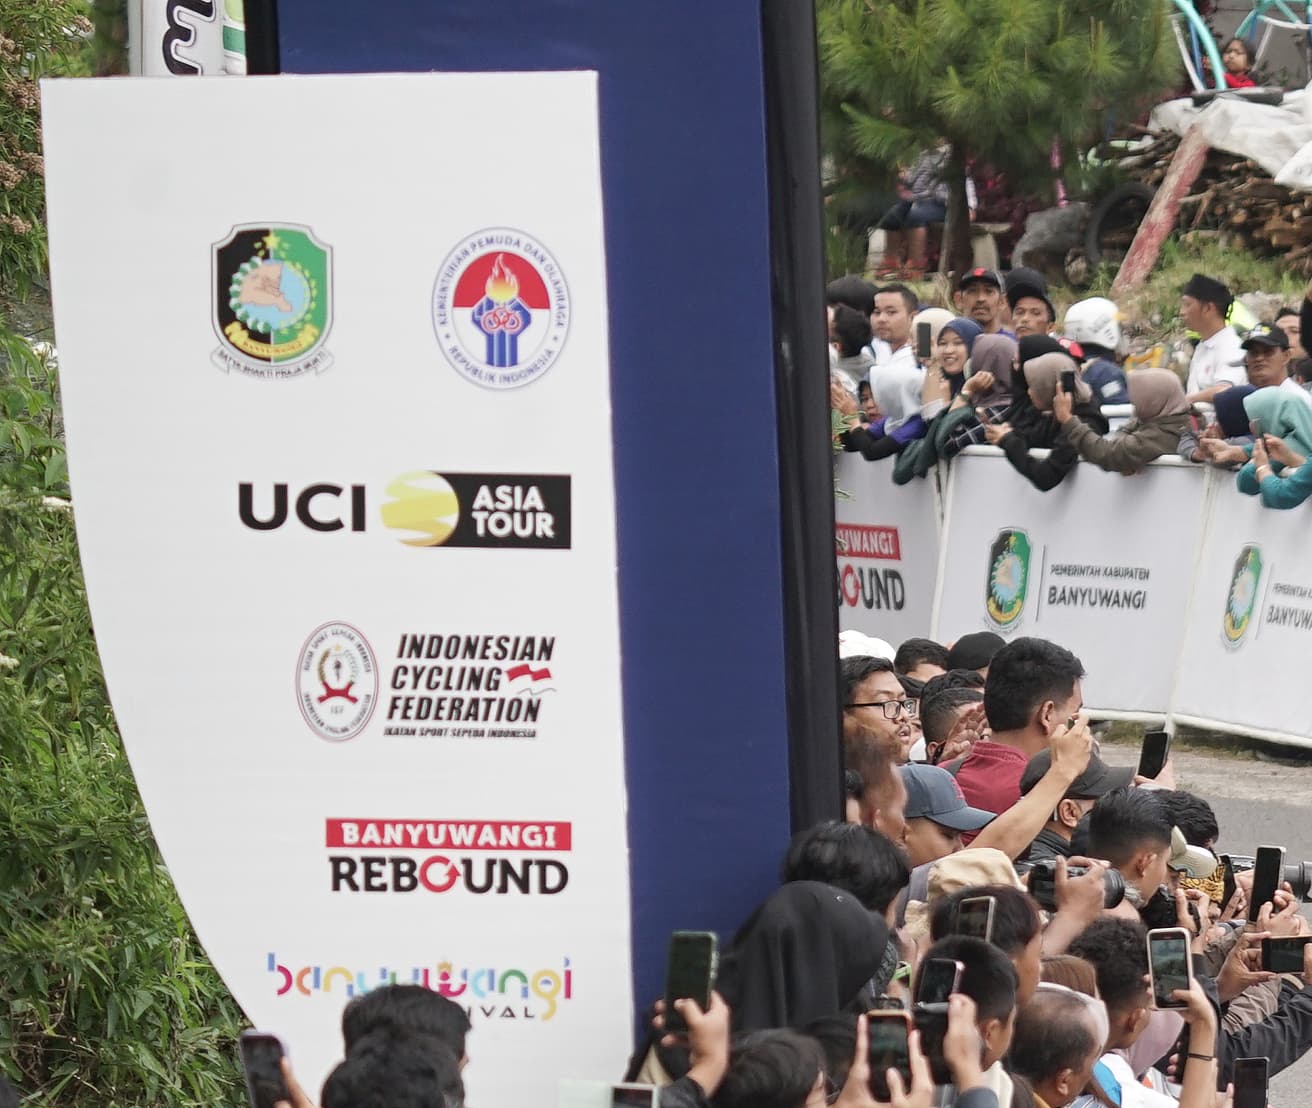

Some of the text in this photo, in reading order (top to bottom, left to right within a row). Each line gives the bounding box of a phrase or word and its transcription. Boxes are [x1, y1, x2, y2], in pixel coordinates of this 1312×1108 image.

[470, 235, 521, 252] PEMUDA
[523, 242, 545, 264] DAN
[238, 482, 366, 532] UCI
[472, 485, 544, 510] ASIA
[471, 511, 555, 538] TOUR
[1050, 564, 1150, 581] PEMERINTAH KABUPATEN
[1047, 585, 1147, 611] BANYUWANGI
[396, 633, 555, 661] INDONESIAN
[391, 665, 502, 692] CYCLING
[387, 696, 541, 722] FEDERATION
[341, 822, 556, 848] BANYUWANGI
[328, 855, 569, 895] REBOUND
